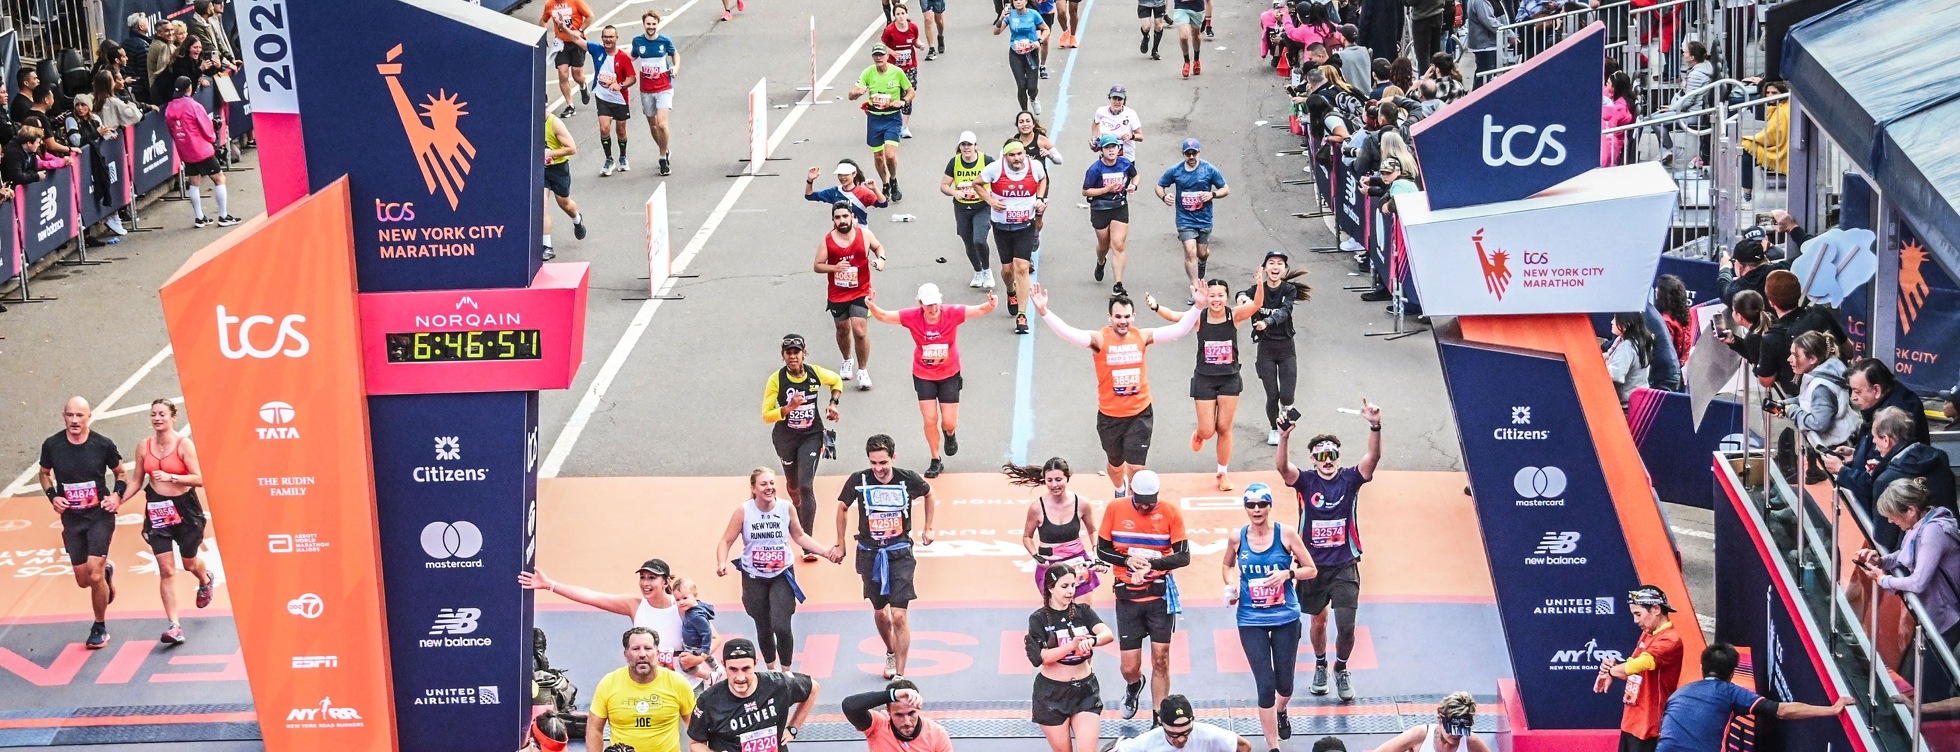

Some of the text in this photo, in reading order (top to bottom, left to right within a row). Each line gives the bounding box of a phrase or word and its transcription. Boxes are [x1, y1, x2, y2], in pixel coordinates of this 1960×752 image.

[249, 0, 293, 93] 202
[1482, 114, 1566, 167] tcs
[1002, 189, 1031, 197] ITALIA
[375, 198, 416, 222] tcs
[1007, 210, 1029, 218] 30684
[378, 225, 504, 242] NEW YORK CITY
[380, 243, 475, 259] MARATHON
[1523, 250, 1548, 265] tcs
[1523, 267, 1605, 278] NEW YORK CITY
[1523, 279, 1584, 288] MARATHON
[415, 313, 521, 328] NORQAIN
[1848, 315, 1865, 336] tc
[216, 305, 310, 360] tcs
[922, 350, 948, 359] 46466
[1206, 346, 1232, 356] 37243
[1911, 350, 1938, 364] CITY
[789, 409, 815, 419] 52543
[255, 426, 301, 440] TATA
[1493, 428, 1550, 440] Citizens
[412, 466, 488, 482] Citizens
[257, 476, 315, 486] THE RUDIN
[66, 489, 96, 500] 34874
[270, 487, 307, 497] FAMILY
[1515, 498, 1565, 507] mastercard
[150, 507, 176, 518] 51856
[751, 521, 781, 531] NEW YORK
[871, 517, 900, 529] 42518
[750, 531, 775, 540] RUNNING
[1313, 526, 1345, 537] 32574
[753, 551, 783, 561] 42956
[1524, 556, 1587, 565] new balance
[425, 558, 483, 569] mastercard
[1241, 564, 1280, 575] FIONA
[1545, 598, 1592, 606] UNITED
[1534, 606, 1592, 614] AIRLINES
[419, 636, 492, 648] new balance
[291, 655, 338, 669] ESPN
[425, 687, 476, 697] UNITED
[413, 696, 477, 705] AIRLINES
[634, 717, 652, 728] JOE
[729, 706, 778, 731] OLIVER
[743, 735, 778, 752] 47320
